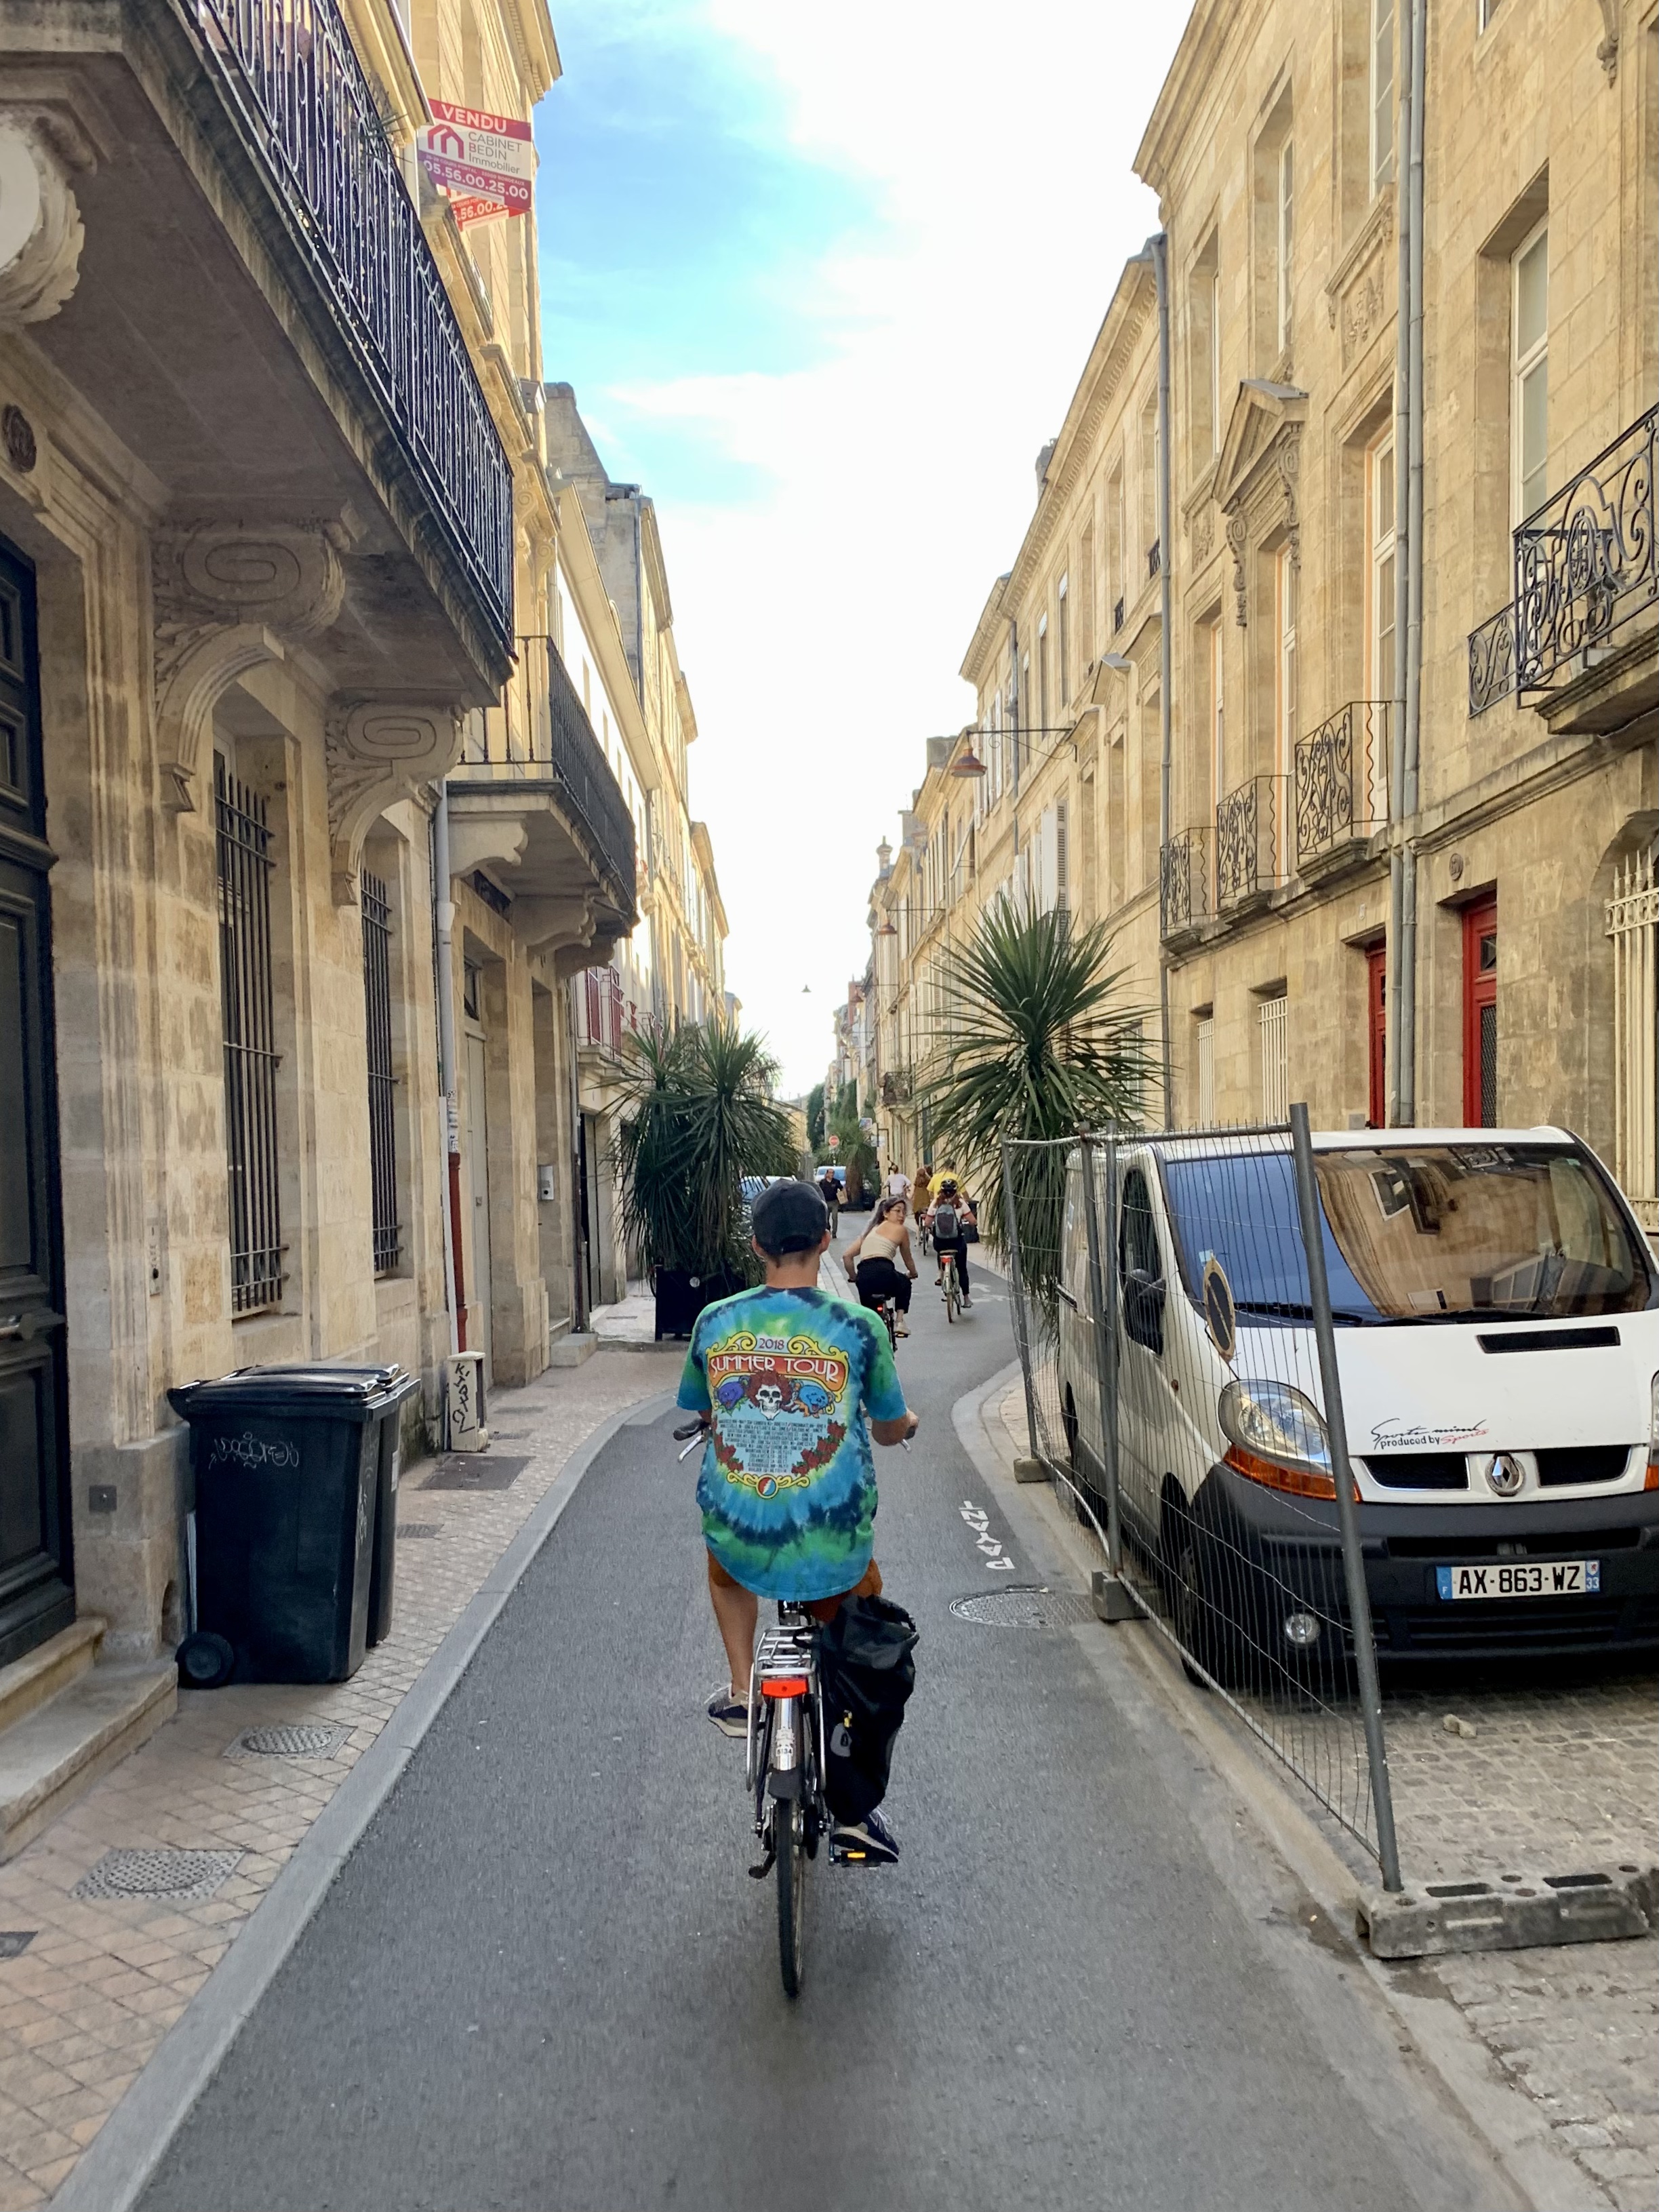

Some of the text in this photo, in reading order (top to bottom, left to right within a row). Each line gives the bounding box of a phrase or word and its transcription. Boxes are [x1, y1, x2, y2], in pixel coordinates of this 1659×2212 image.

[441, 103, 507, 134] VENDU
[468, 131, 523, 153] CABINET
[468, 142, 507, 161] BEDIN
[468, 152, 521, 174] Immobilier
[423, 159, 529, 200] 05.56.00.25.00
[497, 174, 525, 186] BORDEAUX
[759, 1338, 785, 1350] 2018
[710, 1355, 839, 1384] SUMMER TOUR
[1380, 1434, 1427, 1450] produced
[1428, 1434, 1441, 1446] by
[1441, 1565, 1600, 1594] F AX-863-WZ 33
